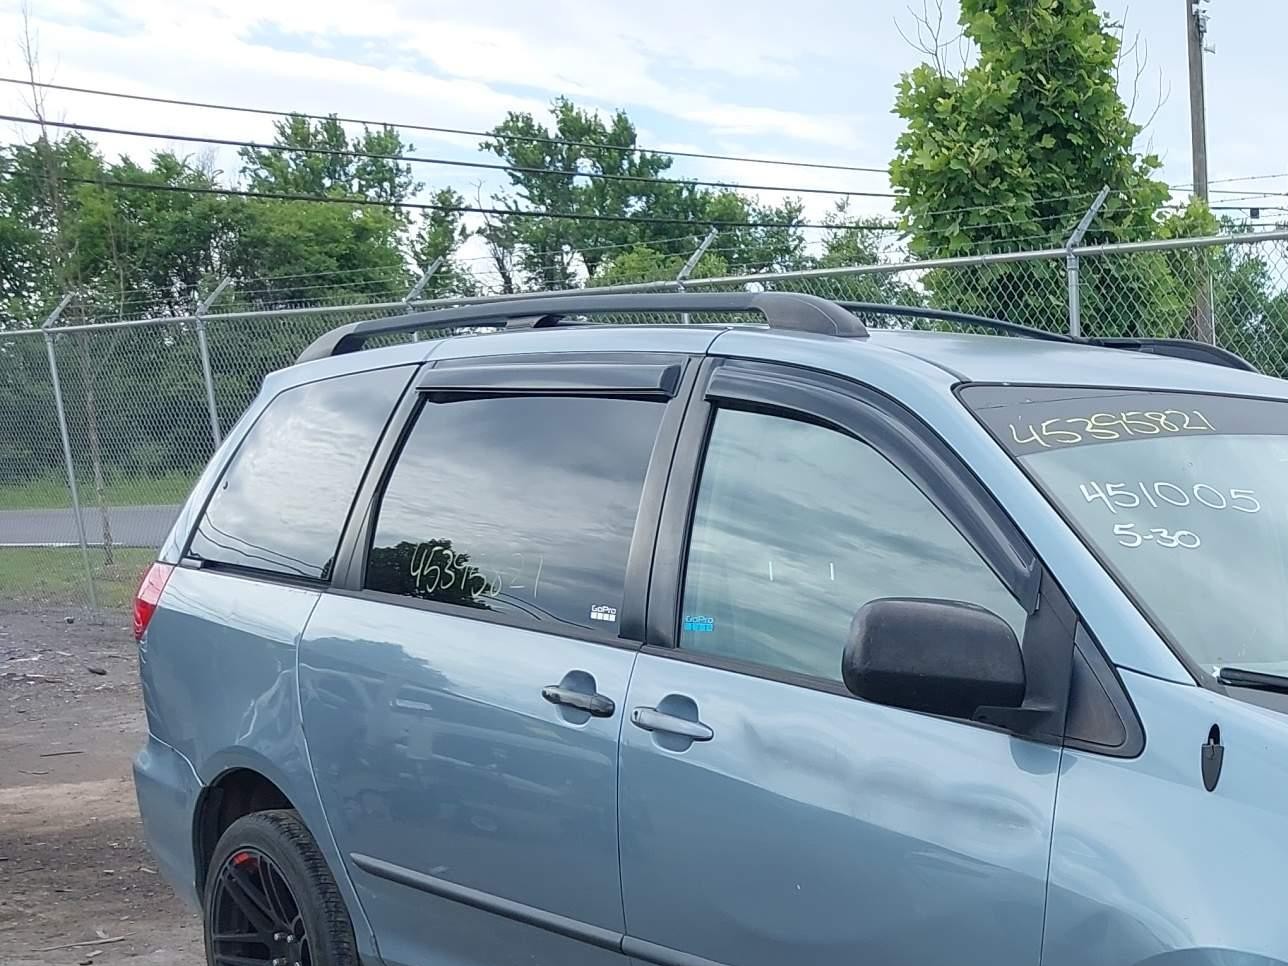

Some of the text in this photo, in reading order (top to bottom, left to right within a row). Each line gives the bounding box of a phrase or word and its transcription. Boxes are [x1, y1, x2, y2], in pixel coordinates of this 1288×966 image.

[1009, 408, 1216, 447] 45395821
[1079, 481, 1261, 513] 451005
[1113, 523, 1200, 548] 5-30
[591, 604, 617, 615] GoPro
[685, 615, 714, 624] GoPro
